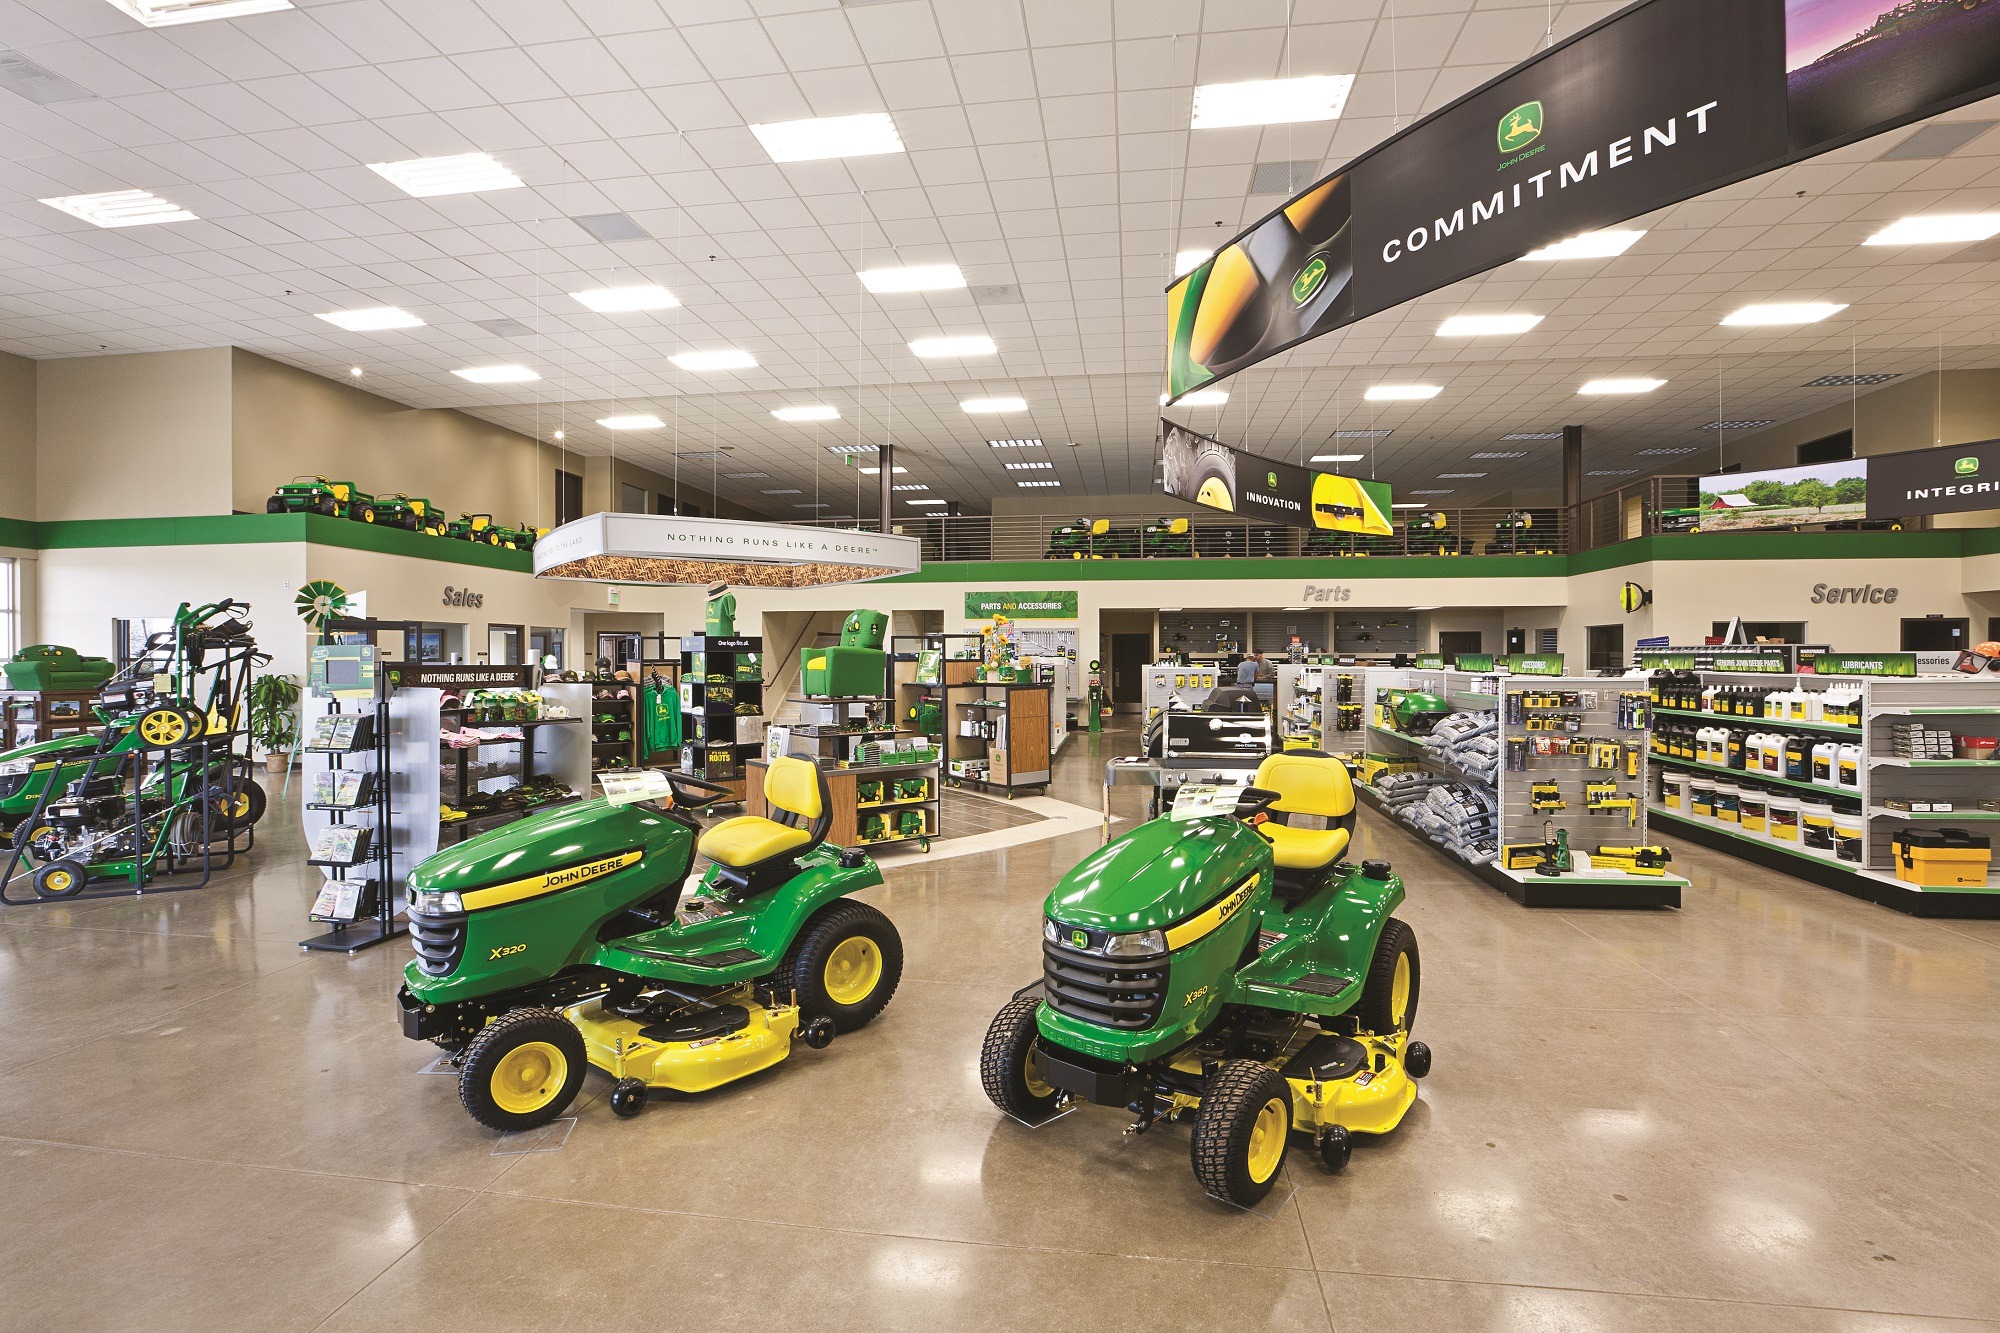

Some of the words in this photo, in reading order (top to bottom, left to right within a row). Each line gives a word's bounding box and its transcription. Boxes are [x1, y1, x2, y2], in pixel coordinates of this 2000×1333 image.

[1496, 156, 1518, 172] JOHN
[1518, 144, 1546, 161] DEERE
[1382, 100, 1717, 263] COMMITMENT
[1906, 481, 2000, 500] INTEGRI
[1246, 491, 1301, 512] INNOVATION
[667, 533, 734, 544] NOTHING
[743, 537, 779, 547] RUNS
[786, 541, 814, 549] LIKE
[821, 543, 828, 551] A
[443, 585, 483, 608] Sales
[1303, 584, 1351, 602] Parts
[1811, 583, 1899, 604] Service
[980, 602, 1001, 610] PARTS
[1002, 602, 1017, 610] AND
[1018, 602, 1062, 610] ACCESSORIES
[1716, 659, 1735, 667] GENUINE
[1736, 659, 1748, 667] JOHN
[1748, 659, 1764, 667] DEERE
[1842, 660, 1883, 670] LUBRICANTS
[1917, 656, 1950, 665] essories
[420, 673, 455, 683] NOTHING
[455, 673, 475, 682] RUNS
[476, 672, 489, 682] LIKE
[490, 672, 495, 681] A
[709, 754, 731, 762] ROOTS
[542, 873, 579, 888] JOHN
[581, 859, 623, 877] DEERE
[1218, 897, 1238, 920] JOHN
[1235, 882, 1254, 907] DEERE
[488, 943, 527, 961] X320
[1183, 984, 1208, 1008] X360
[1044, 1028, 1073, 1048] JOHN
[1074, 1038, 1121, 1060] DEERE
